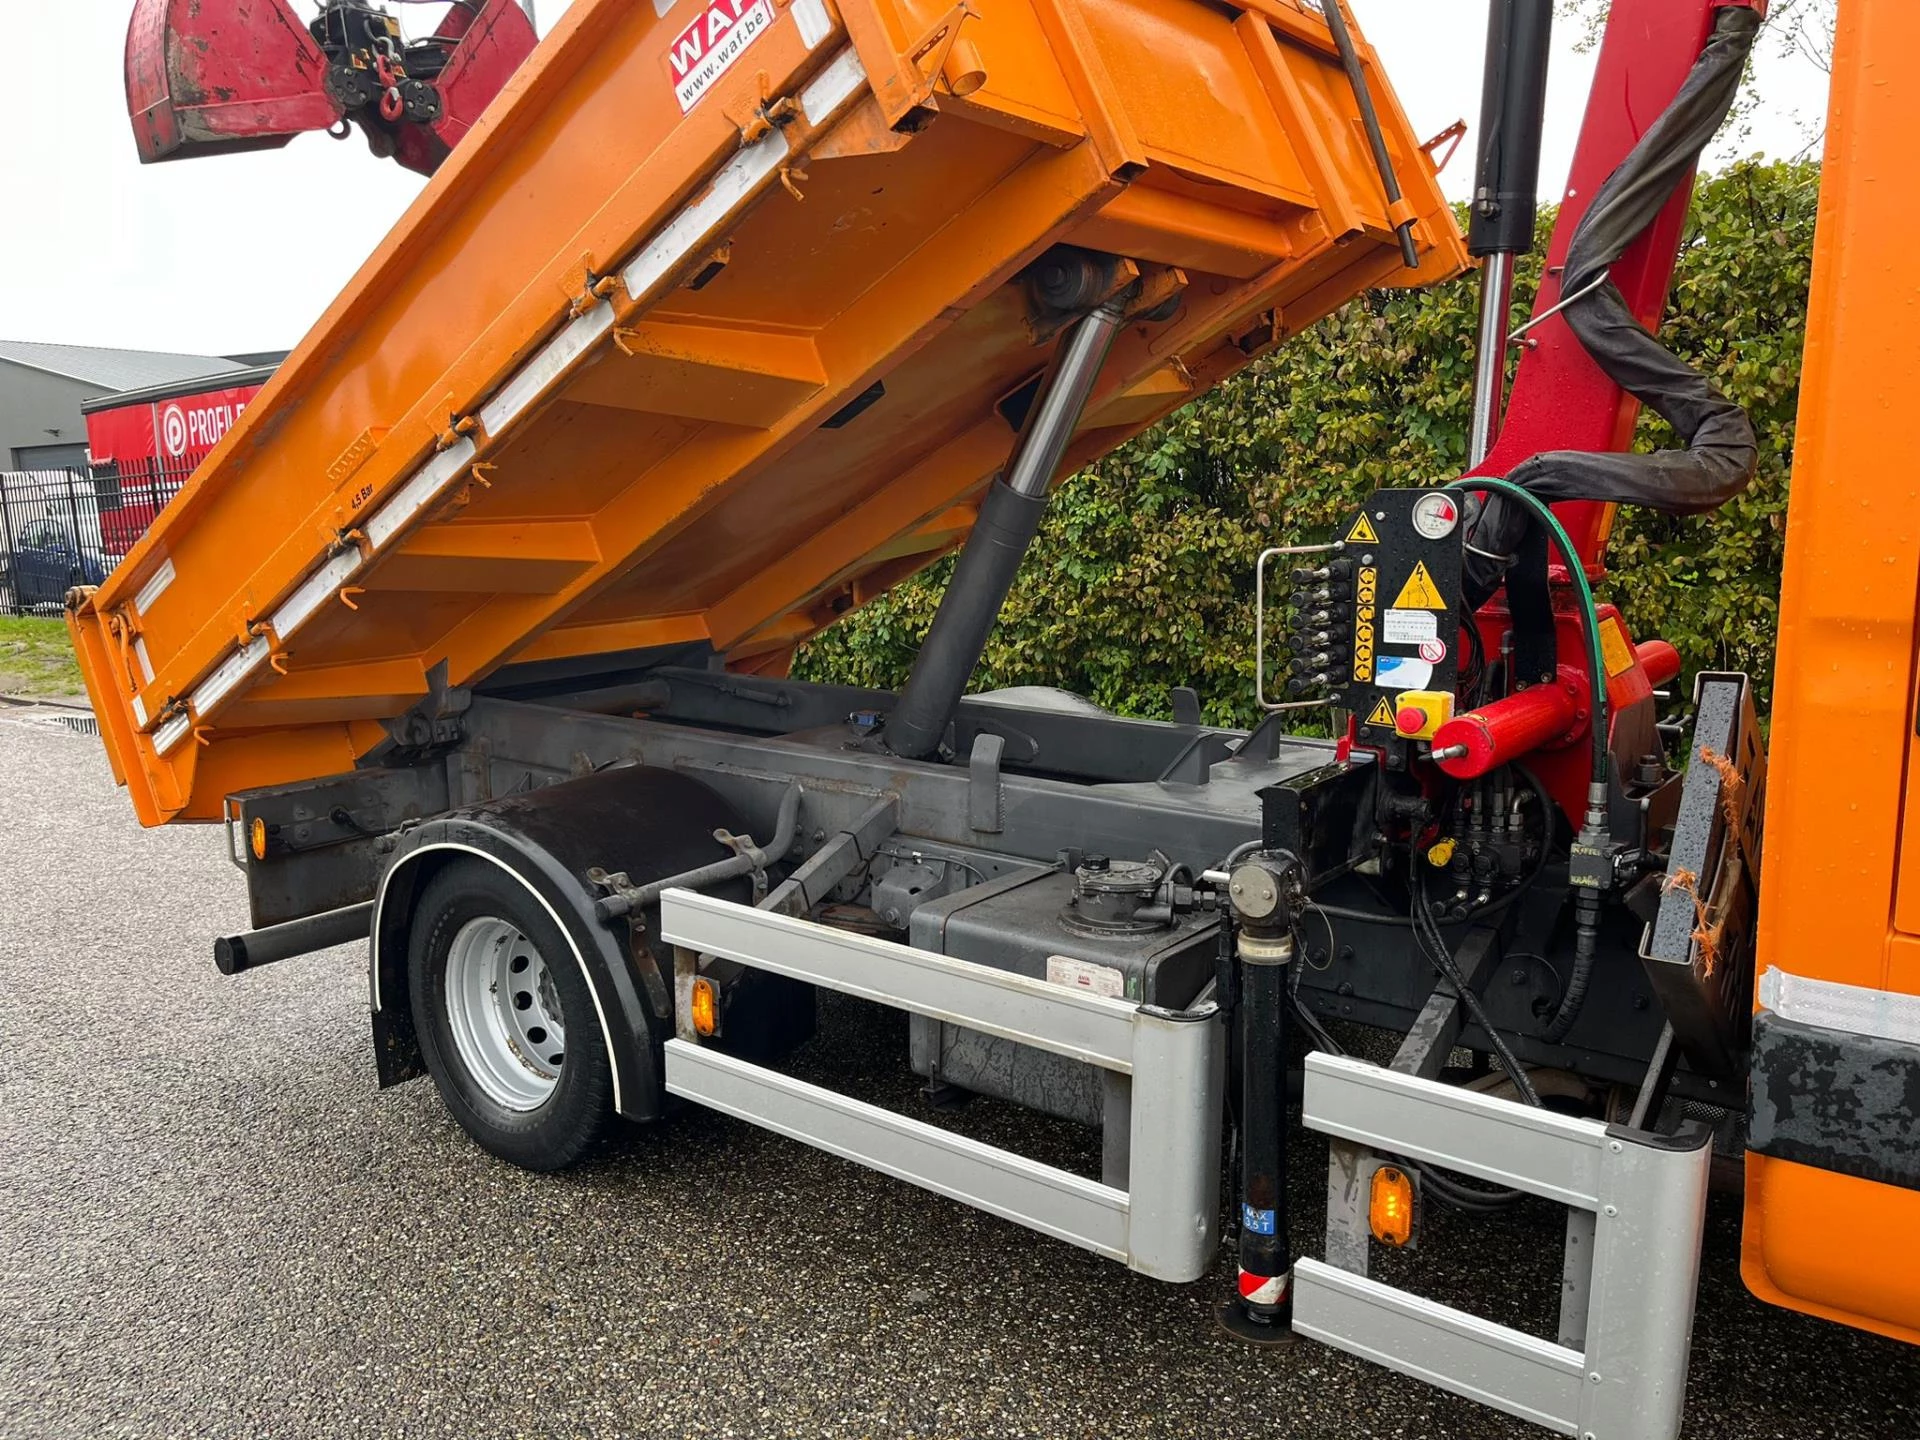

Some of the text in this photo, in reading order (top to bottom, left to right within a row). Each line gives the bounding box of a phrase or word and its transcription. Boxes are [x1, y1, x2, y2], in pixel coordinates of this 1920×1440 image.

[682, 12, 764, 101] www.waf.be
[360, 483, 373, 501] Bar
[1262, 1222, 1270, 1232] T
